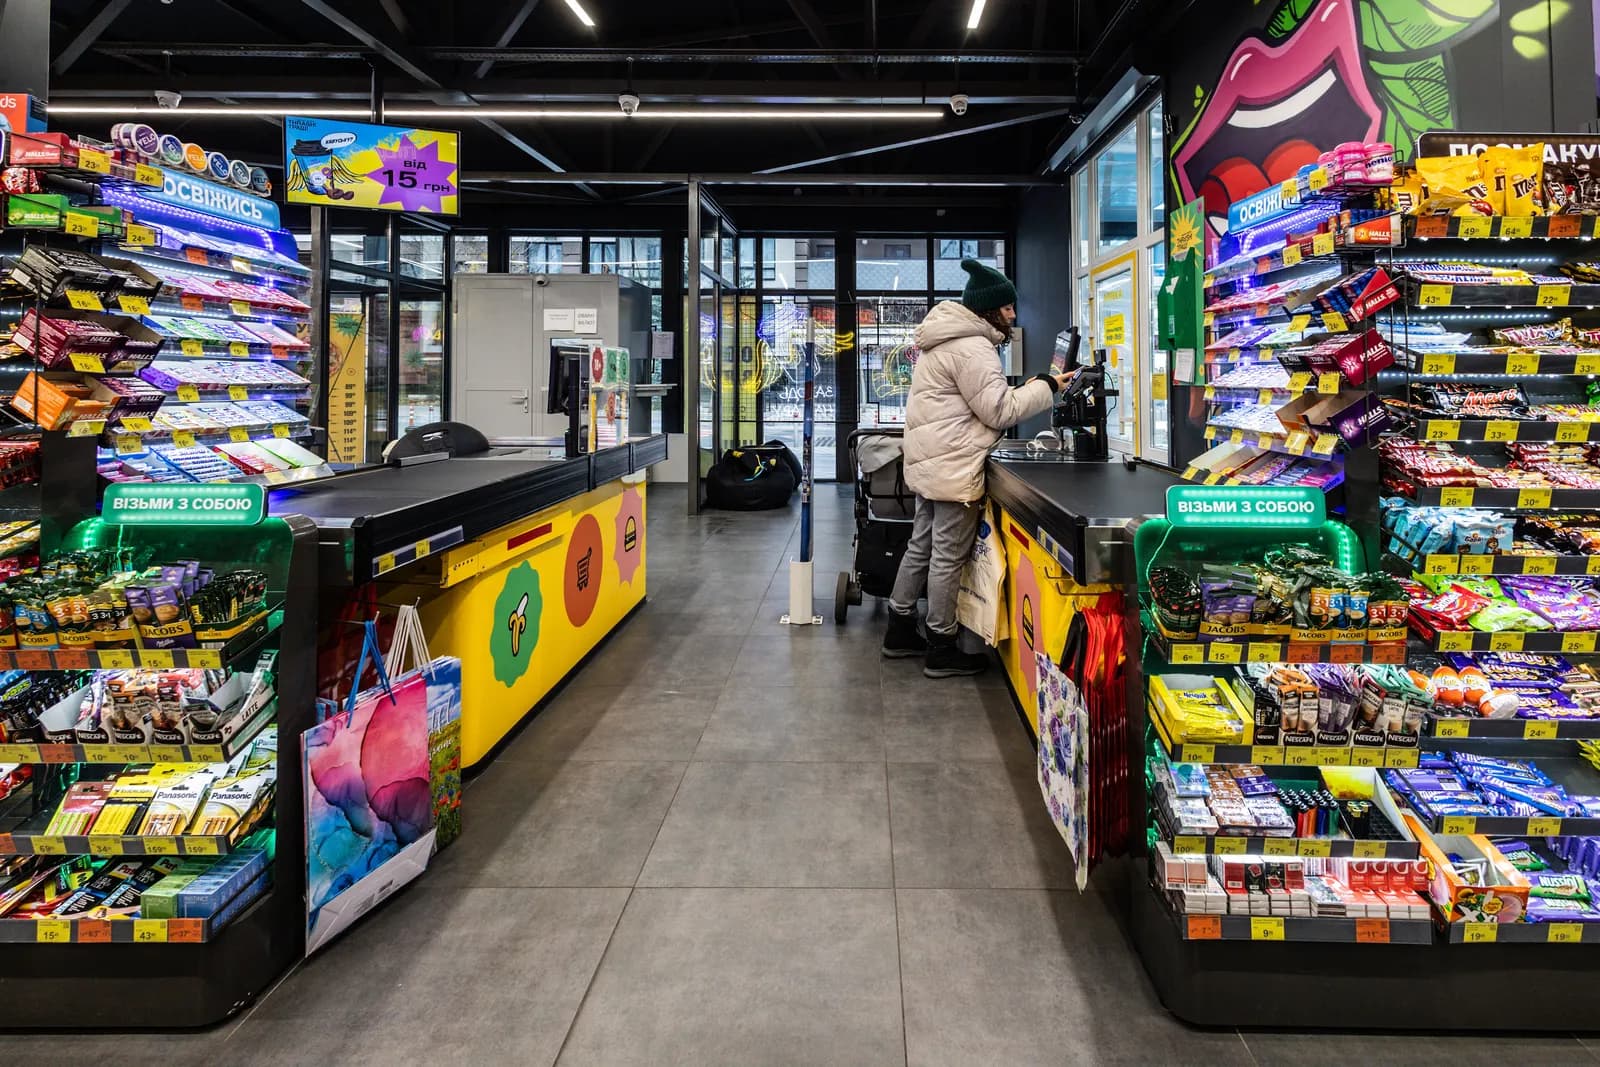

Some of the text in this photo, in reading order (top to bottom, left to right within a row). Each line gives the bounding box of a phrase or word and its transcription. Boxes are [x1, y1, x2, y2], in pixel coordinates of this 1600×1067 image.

[1449, 143, 1600, 164] ПОАКУ
[403, 159, 427, 170] від
[382, 170, 450, 193] 15 грн
[1239, 189, 1302, 223] ОСВІЖИ
[1365, 294, 1387, 310] HALLS
[1360, 342, 1385, 362] HALLS
[113, 498, 252, 510] ВІЗЬМИ З СОБОЮ
[1178, 501, 1315, 513] ВІЗЬМИ З СОБОЮ
[144, 624, 185, 637] JACOBS
[1206, 625, 1246, 634] JACOBS
[1376, 630, 1403, 638] JACOBS
[62, 634, 91, 642] JACOBS
[241, 701, 259, 722] LATTE
[157, 791, 198, 799] Panasonic
[210, 792, 252, 800] Panasonic
